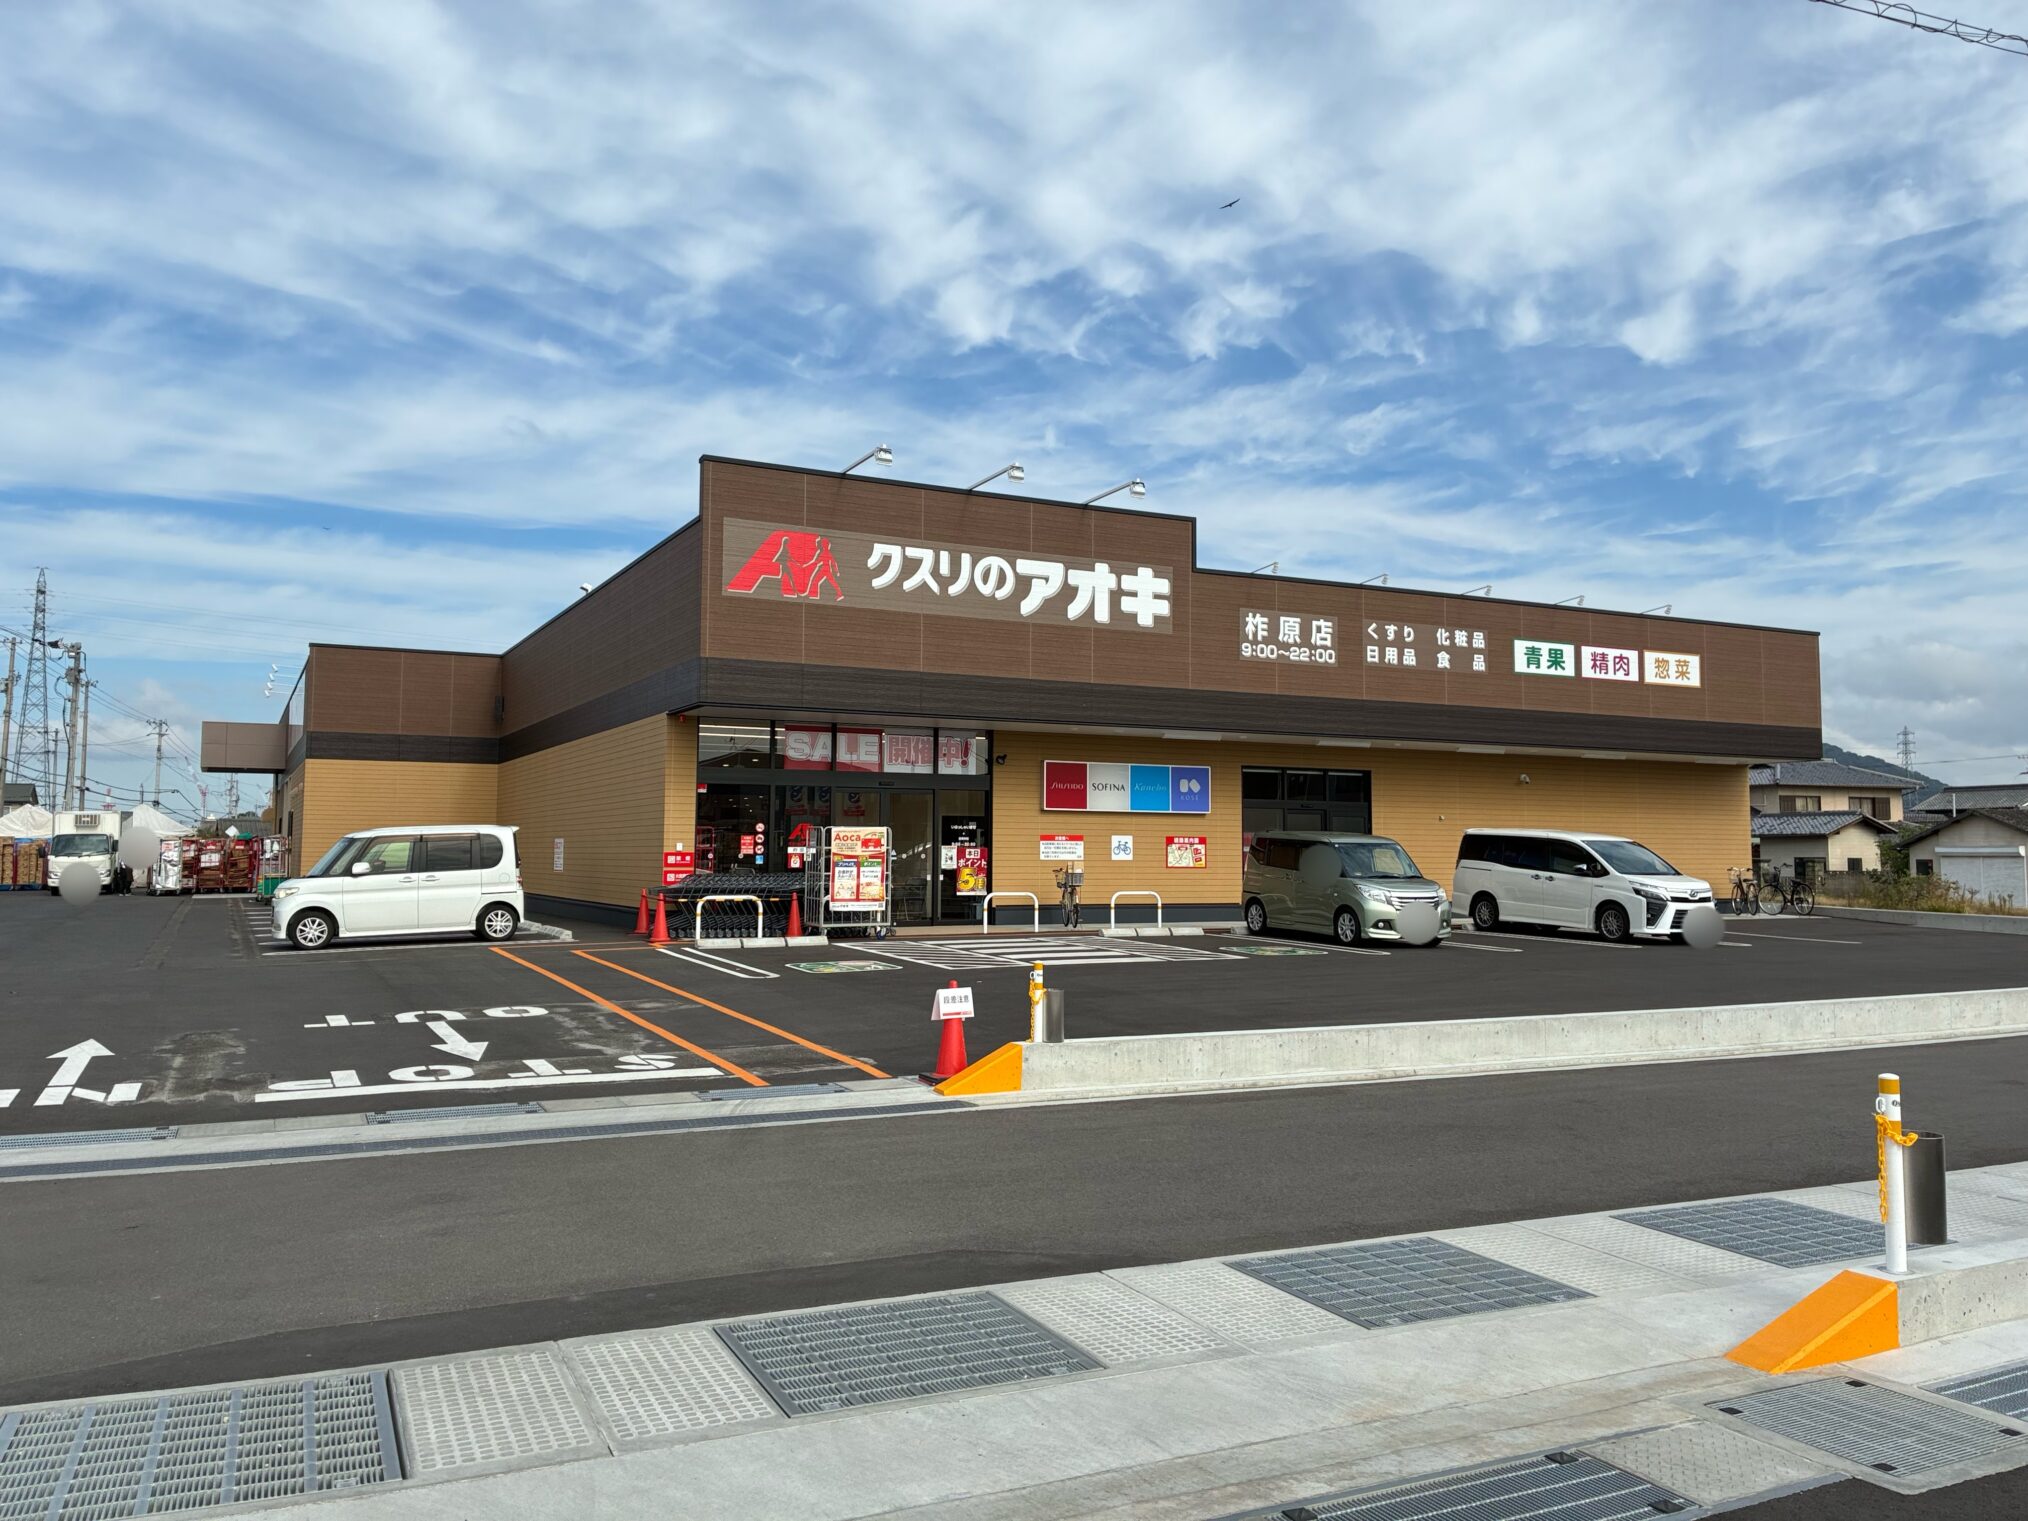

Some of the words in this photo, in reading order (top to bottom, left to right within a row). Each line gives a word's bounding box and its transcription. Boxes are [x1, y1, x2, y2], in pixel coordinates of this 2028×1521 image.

[866, 542, 1171, 628] クスリのアオキ
[1245, 612, 1333, 648] 柞原店
[1367, 622, 1415, 643] くすり
[1436, 628, 1486, 650] 化粧品
[1366, 645, 1417, 667] 日用品
[1523, 645, 1566, 672] 青果
[1590, 651, 1631, 677] 精肉
[1654, 656, 1691, 681] 惣菜
[786, 731, 881, 764] SALE
[1091, 782, 1126, 792] SOFINA
[833, 833, 861, 842] Aoca
[958, 858, 987, 868] ポイント
[966, 849, 980, 857] 本日
[303, 1006, 549, 1029] OUT
[268, 1054, 677, 1091] STOP
